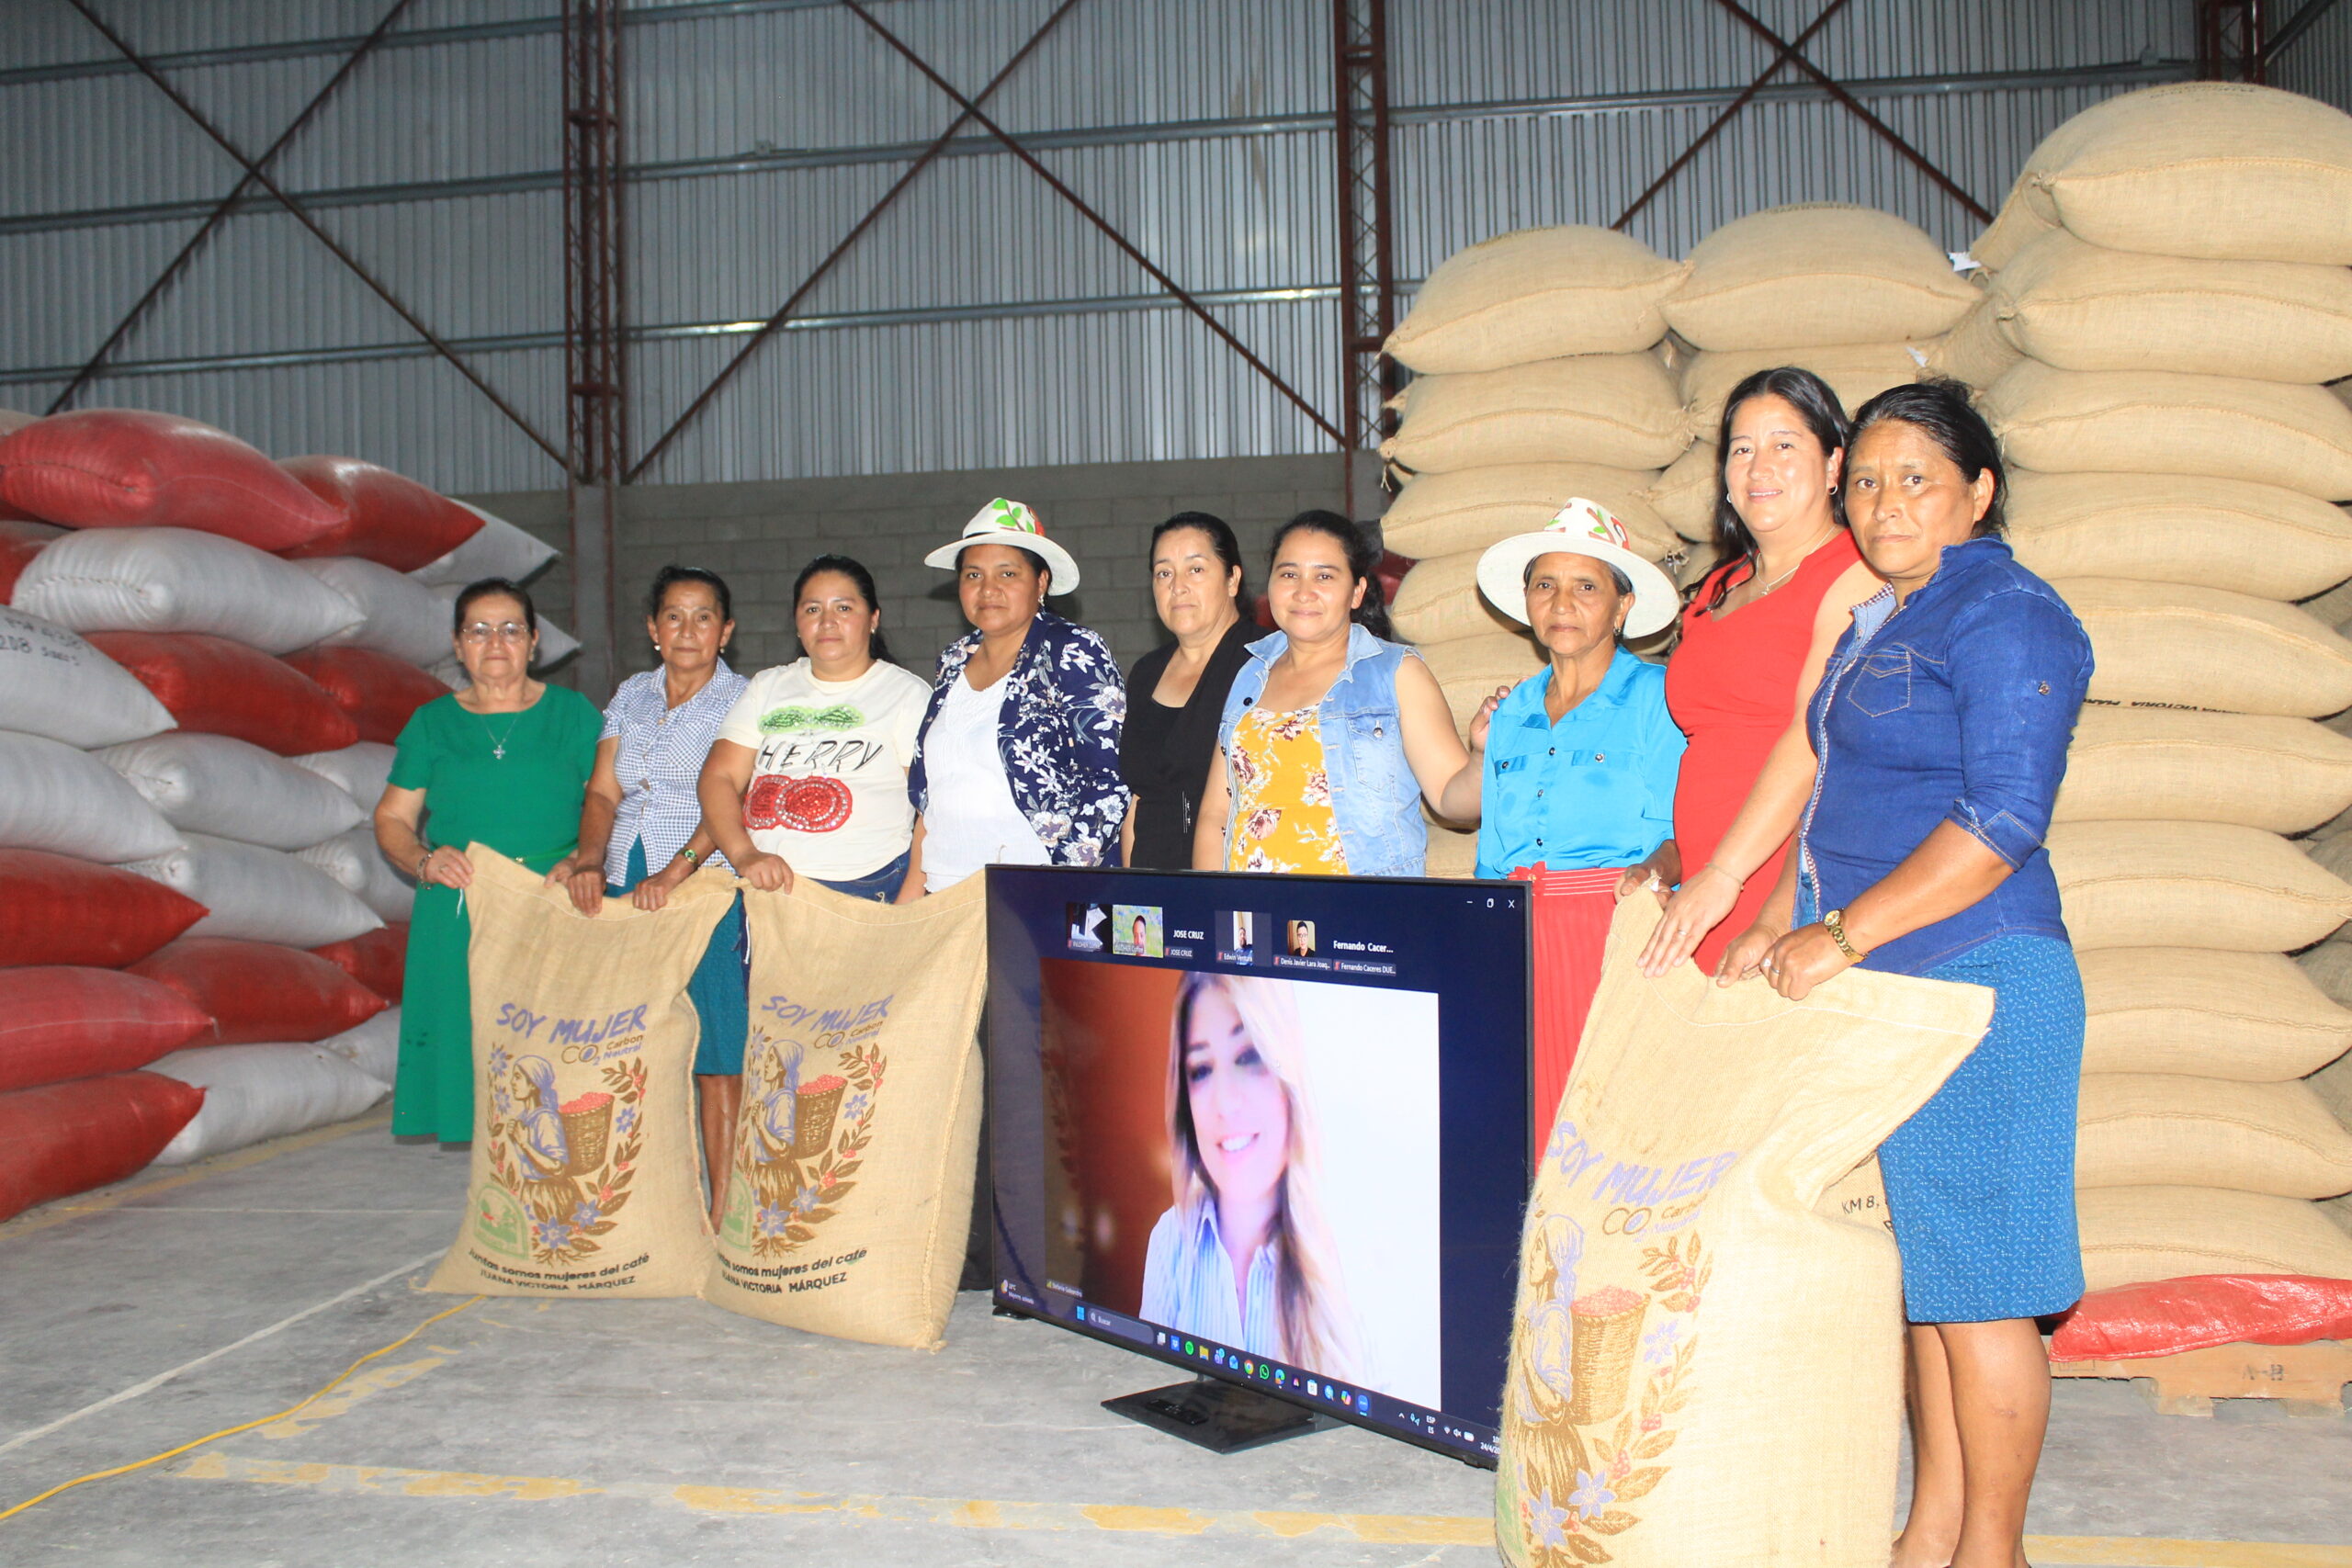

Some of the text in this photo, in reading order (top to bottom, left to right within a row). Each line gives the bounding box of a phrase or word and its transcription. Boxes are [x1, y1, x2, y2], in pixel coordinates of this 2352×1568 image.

[2132, 700, 2198, 712] VICTORIA
[1173, 930, 1204, 941] JOSE CRUZ
[1333, 940, 1366, 952] Fernando
[1280, 957, 1294, 966] Denis
[1340, 962, 1363, 972] Fernando
[1363, 964, 1382, 973] Caceres
[762, 994, 895, 1032] SOY MUJER
[496, 1002, 648, 1044] SOY MUJER
[605, 1034, 644, 1051] Carbon
[1547, 1121, 1738, 1207] SOY MUJER
[502, 1265, 542, 1280] somos
[544, 1269, 596, 1282] mujeres
[599, 1266, 619, 1278] del
[622, 1252, 650, 1272] café
[761, 1264, 808, 1280] mujeres
[810, 1258, 833, 1272] del
[788, 1270, 848, 1293] MÁRQUEZ
